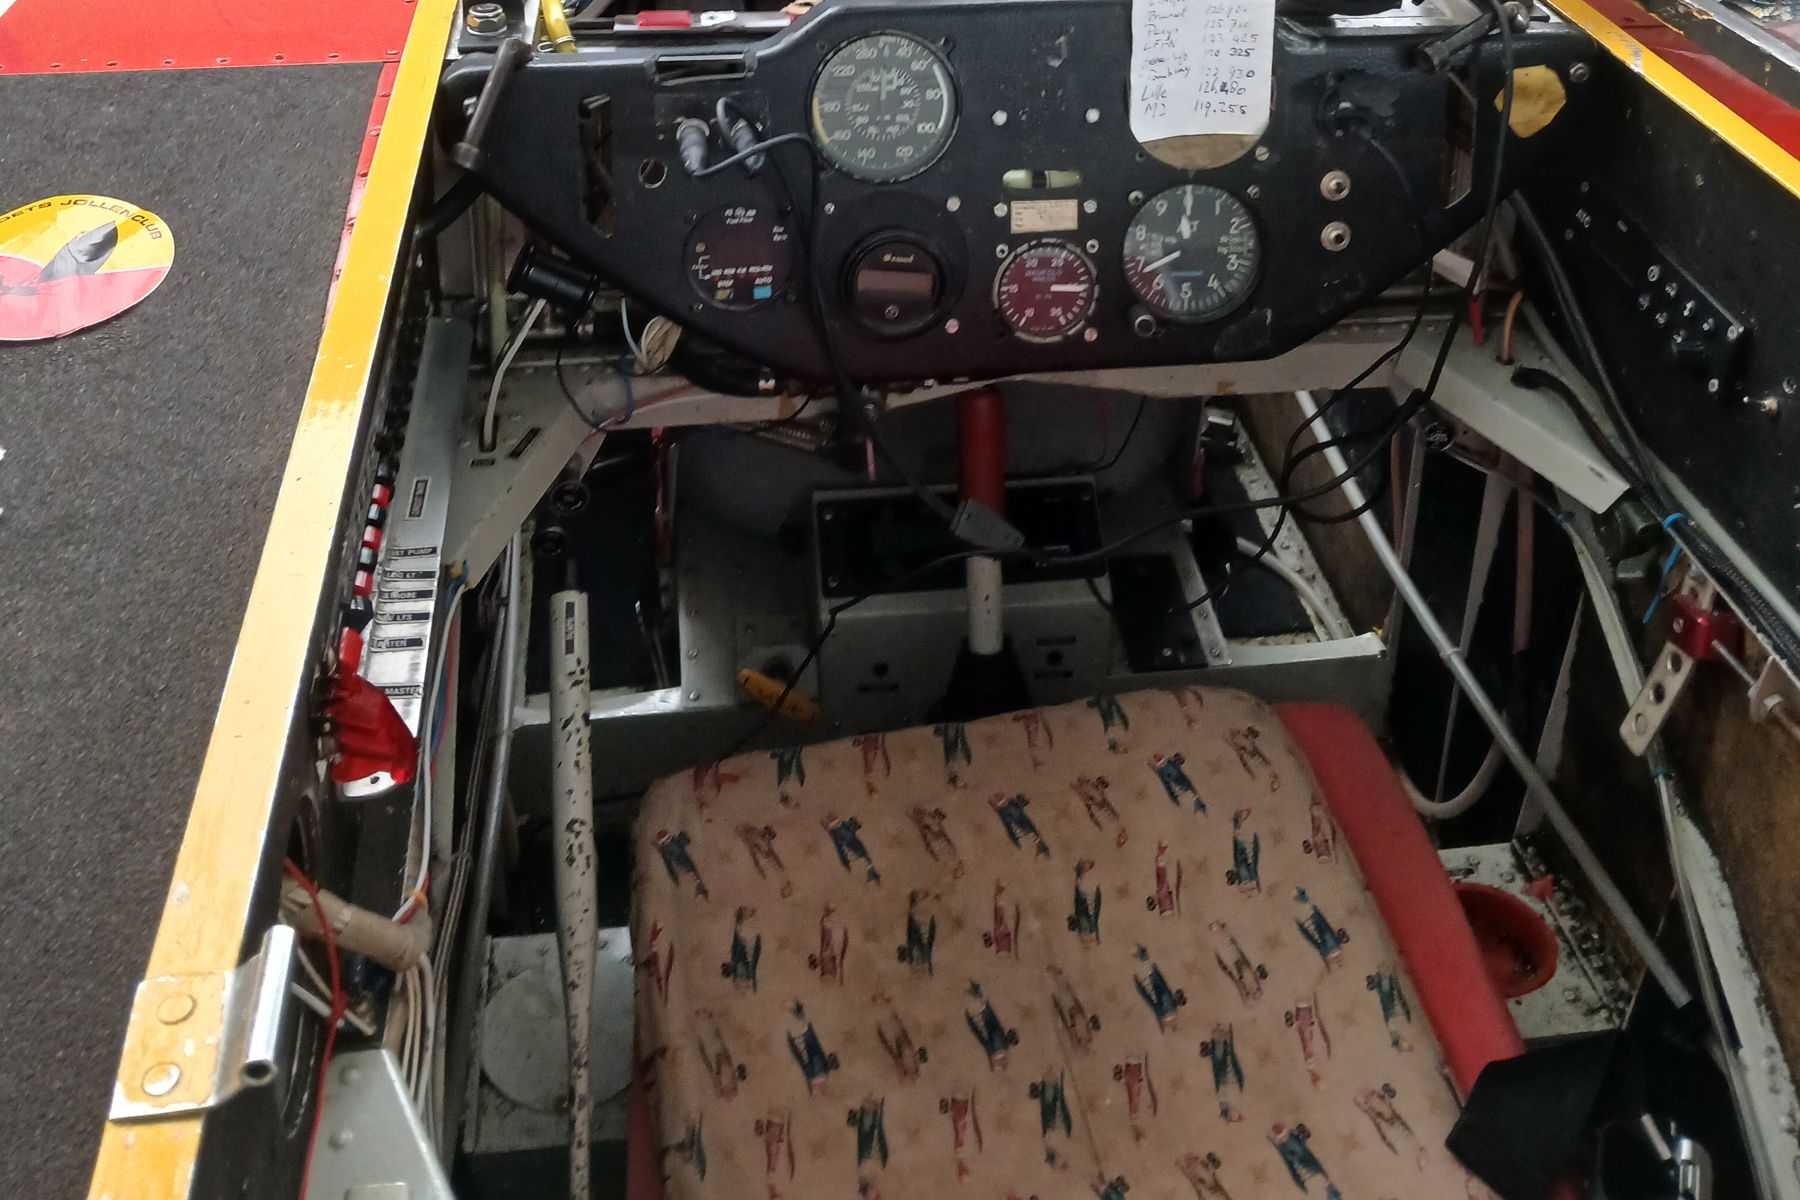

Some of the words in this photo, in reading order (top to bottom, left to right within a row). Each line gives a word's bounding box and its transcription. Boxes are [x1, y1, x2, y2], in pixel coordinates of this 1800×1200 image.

[1156, 200, 1168, 216] 9
[1215, 200, 1221, 216] 1
[1136, 224, 1146, 241] 8
[1229, 217, 1240, 234] 2
[1136, 256, 1145, 272] 7
[1226, 254, 1239, 271] 3
[1152, 273, 1165, 290] 6
[1207, 273, 1219, 290] 4
[1181, 283, 1192, 299] 5
[385, 686, 421, 696] MASTER
